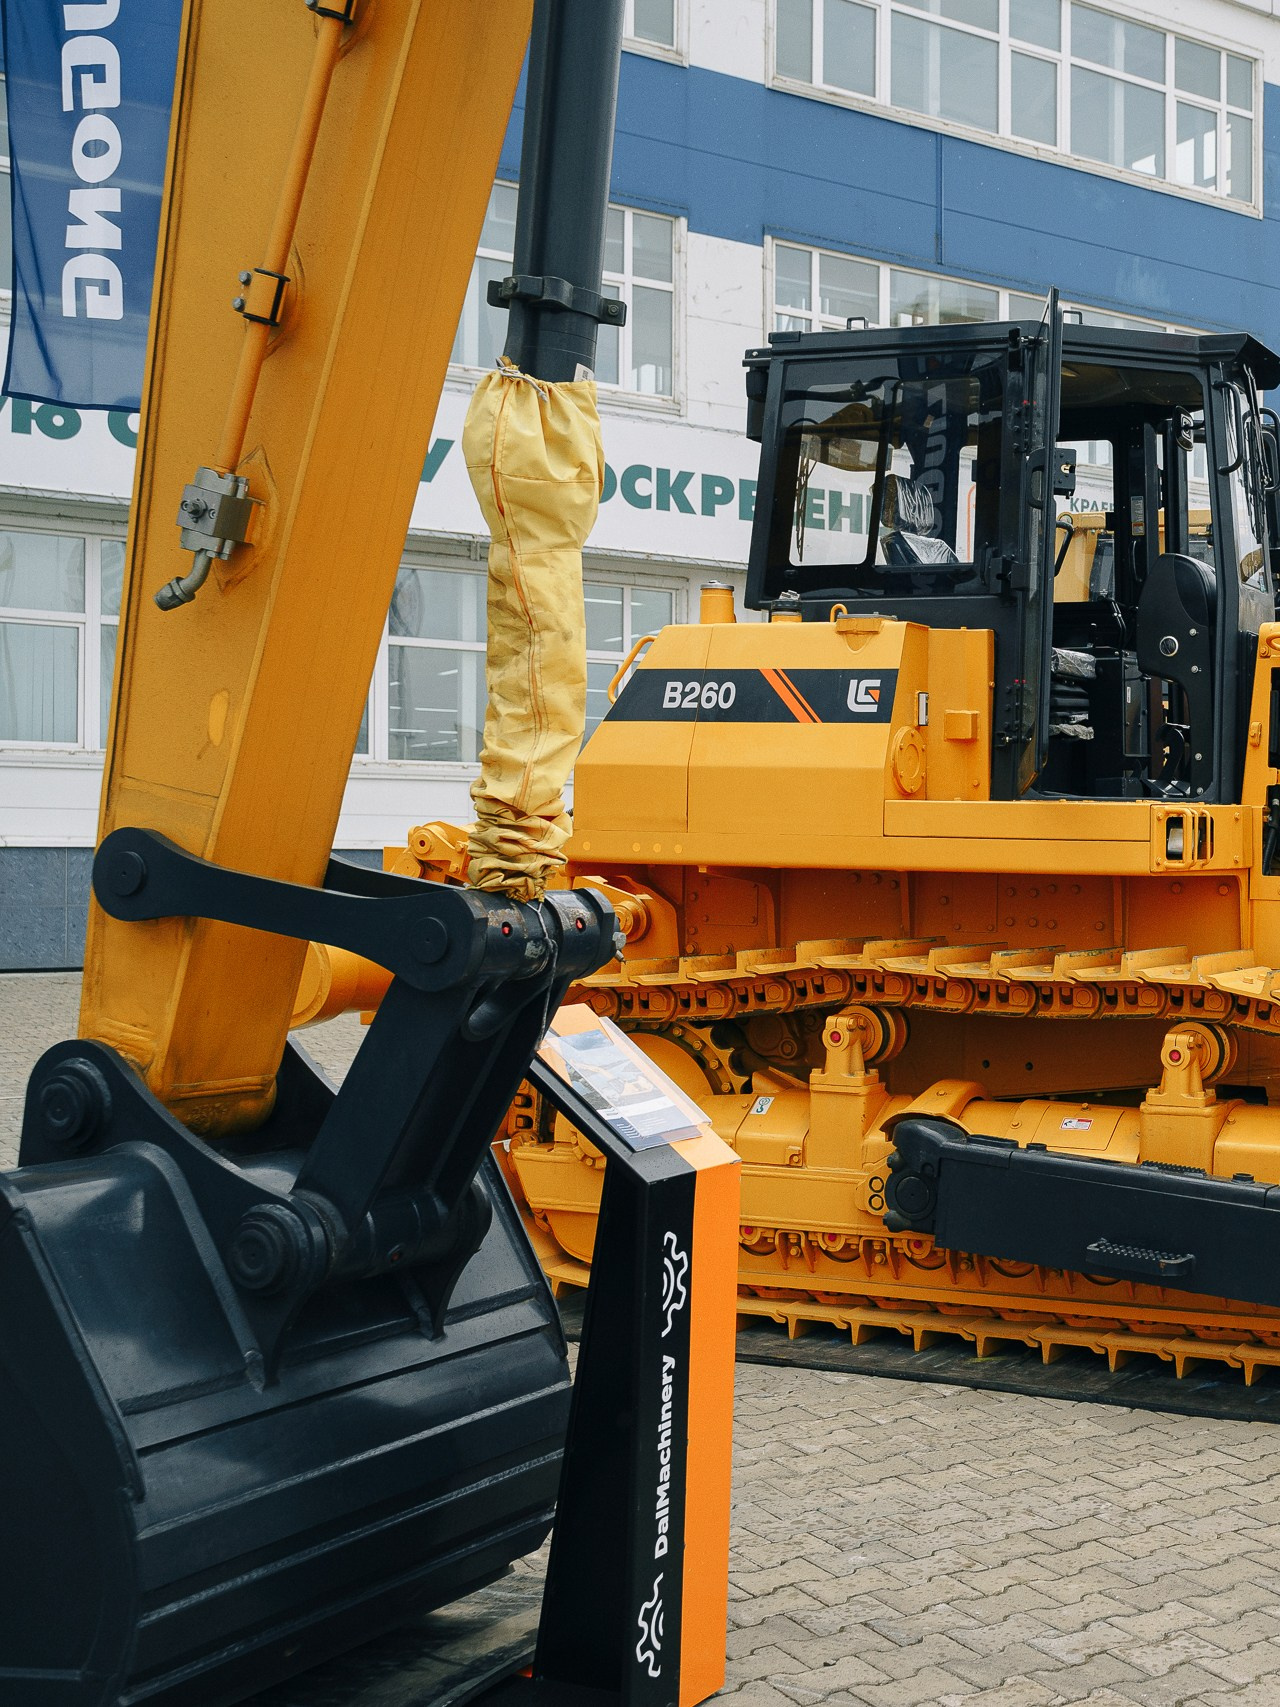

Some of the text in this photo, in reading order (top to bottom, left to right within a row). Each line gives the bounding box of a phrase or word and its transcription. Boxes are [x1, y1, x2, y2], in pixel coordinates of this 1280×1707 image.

[1070, 497, 1114, 513] КРАЕ
[662, 681, 737, 709] B260
[654, 1354, 676, 1560] DalMachinery
